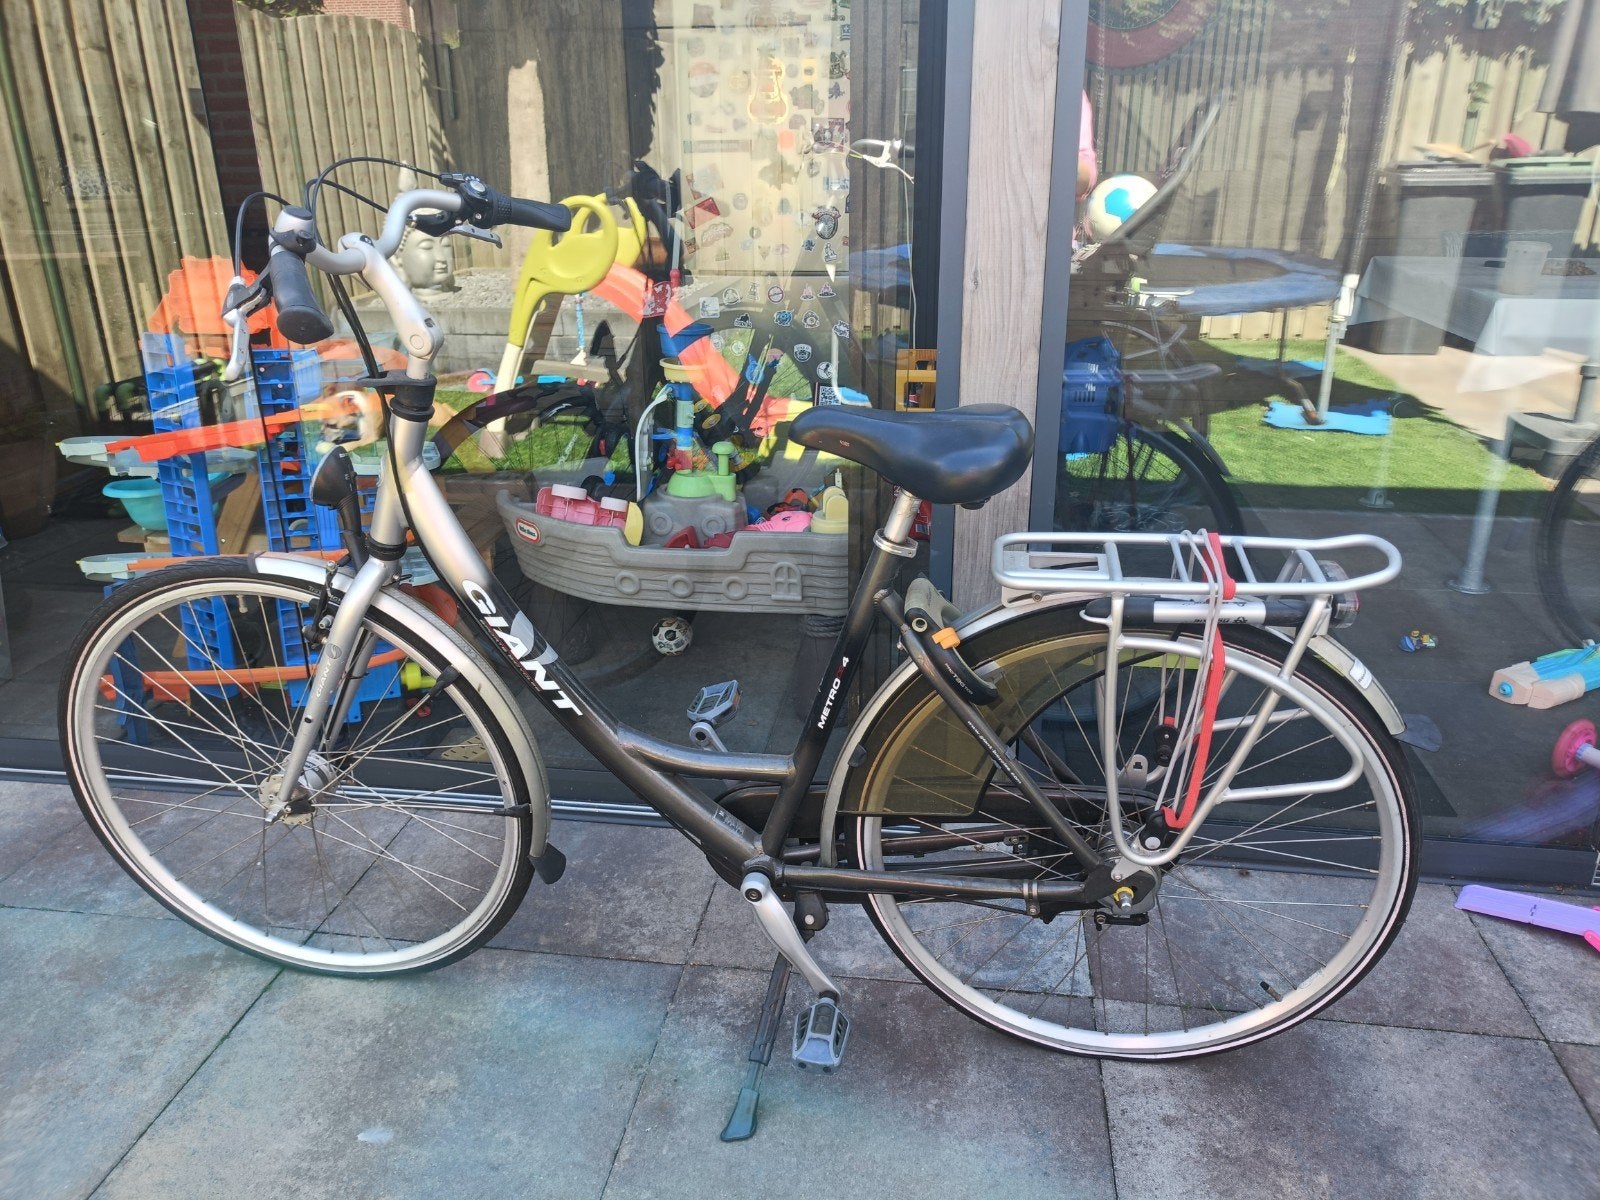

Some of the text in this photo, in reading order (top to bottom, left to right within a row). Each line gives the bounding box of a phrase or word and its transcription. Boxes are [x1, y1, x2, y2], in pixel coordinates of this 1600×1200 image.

[316, 658, 331, 698] GIANT
[462, 580, 583, 716] GIANT
[817, 677, 841, 729] METRO
[842, 656, 850, 668] 4
